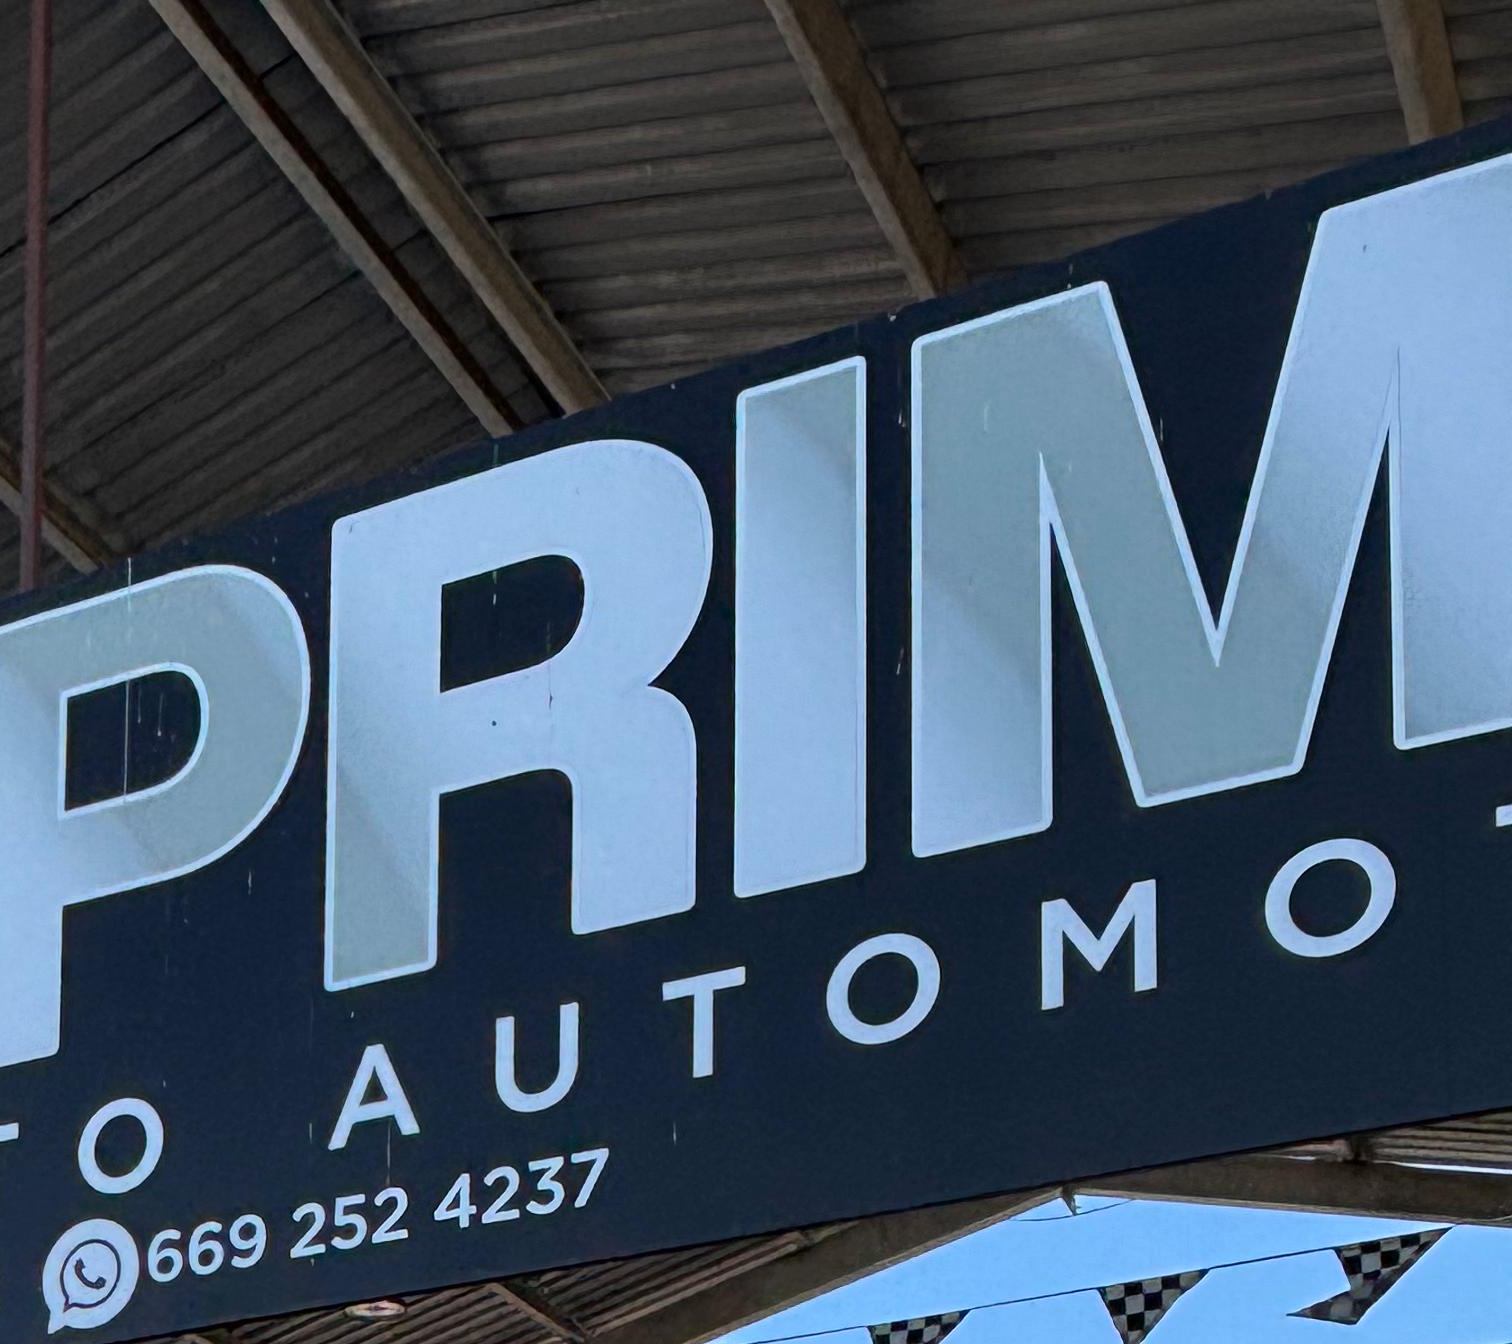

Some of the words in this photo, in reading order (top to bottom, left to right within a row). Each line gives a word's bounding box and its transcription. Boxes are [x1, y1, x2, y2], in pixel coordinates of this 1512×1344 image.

[326, 803, 1512, 1152] AUTOMO
[147, 1213, 268, 1283] 669
[289, 1187, 410, 1259] 252
[433, 1147, 611, 1230] 4237
